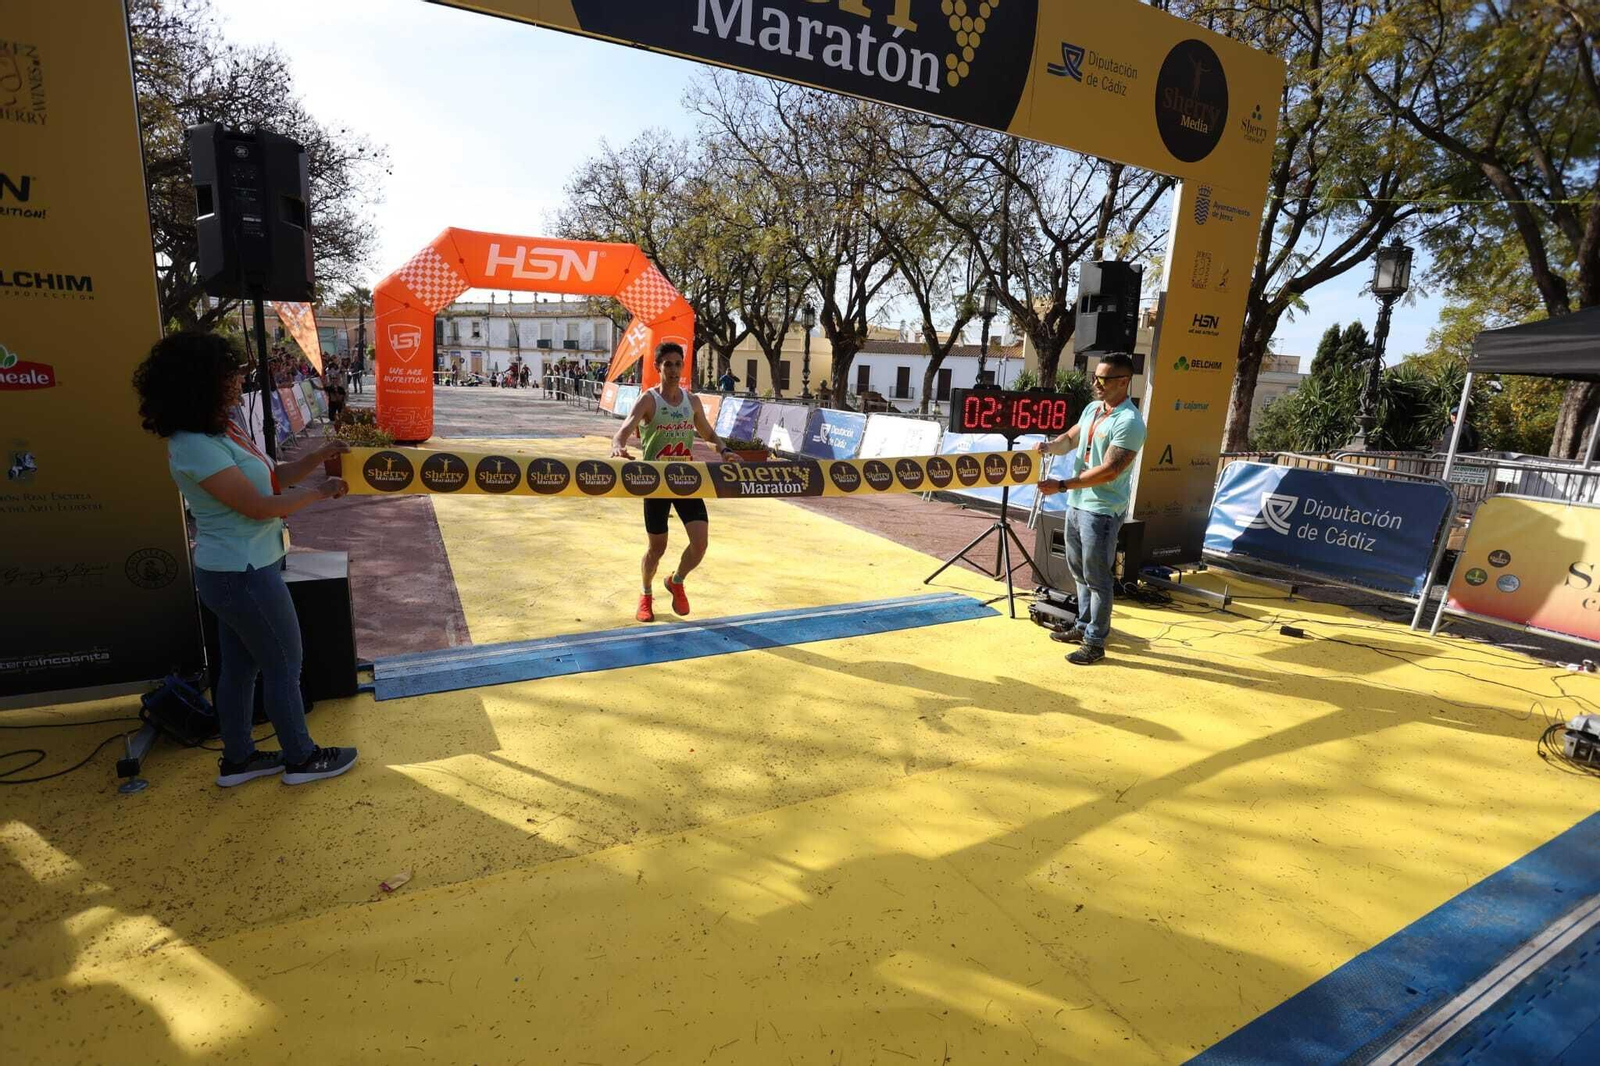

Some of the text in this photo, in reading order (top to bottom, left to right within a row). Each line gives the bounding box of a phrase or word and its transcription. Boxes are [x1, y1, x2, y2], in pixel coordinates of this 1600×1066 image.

[692, 0, 941, 93] Maratón
[1088, 50, 1138, 79] Diputación
[1086, 72, 1127, 96] de Cádiz
[1162, 87, 1221, 130] Sherry
[1180, 114, 1208, 133] Media
[485, 243, 598, 281] HSN
[1193, 313, 1219, 329] HSN
[964, 396, 1067, 429] 02:16:08
[367, 468, 409, 480] Sherry
[424, 470, 464, 480] Sherry
[479, 471, 517, 482] Sherry
[530, 472, 566, 483] Sherry
[579, 472, 612, 483] Sherry
[625, 473, 657, 483] Sherry
[668, 473, 697, 483] Sherry
[719, 462, 808, 486] Sherry
[833, 473, 858, 481] Sherry
[741, 480, 802, 494] Maratón
[1303, 498, 1403, 530] Diputación
[1297, 522, 1376, 552] de Cádiz
[1565, 560, 1600, 592] S
